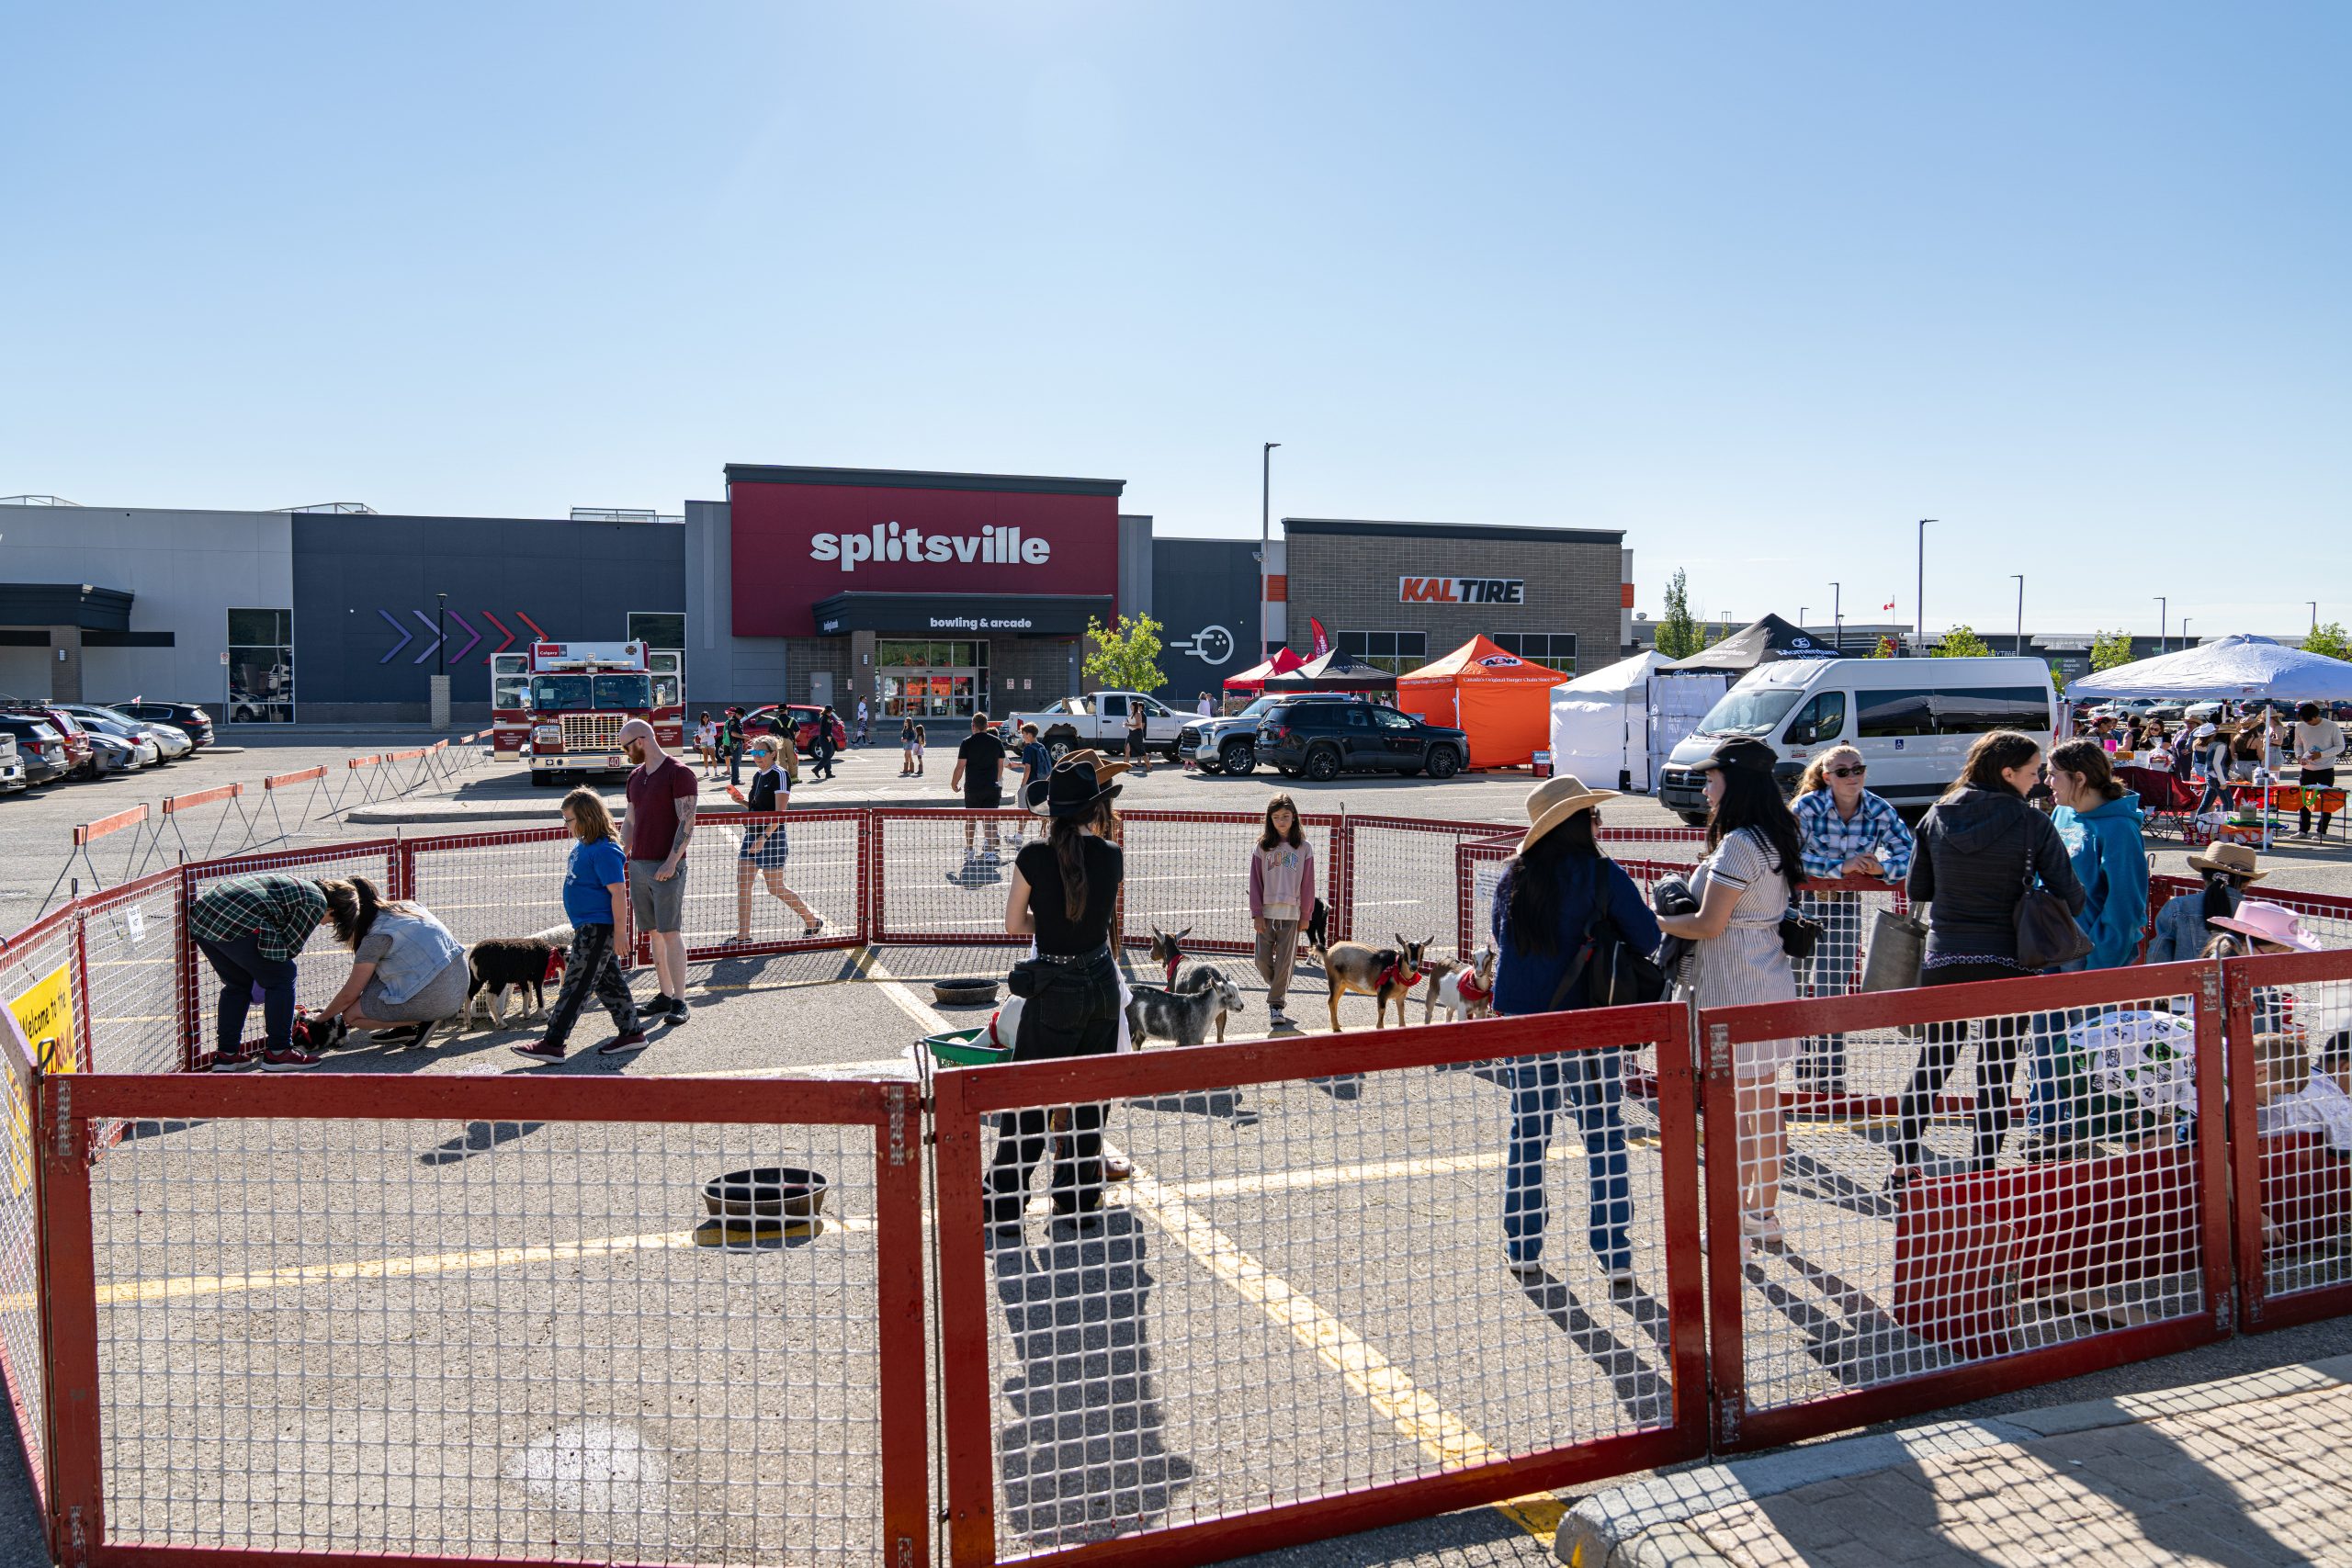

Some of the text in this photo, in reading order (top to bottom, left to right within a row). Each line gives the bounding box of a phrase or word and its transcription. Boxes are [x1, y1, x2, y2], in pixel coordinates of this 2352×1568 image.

[809, 521, 1050, 571] splitsville
[1402, 578, 1523, 603] KAL TIRE
[930, 616, 1032, 630] bowling & arcade
[1485, 658, 1518, 666] A&W
[609, 757, 619, 767] 40
[19, 987, 66, 1039] Welcome to the
